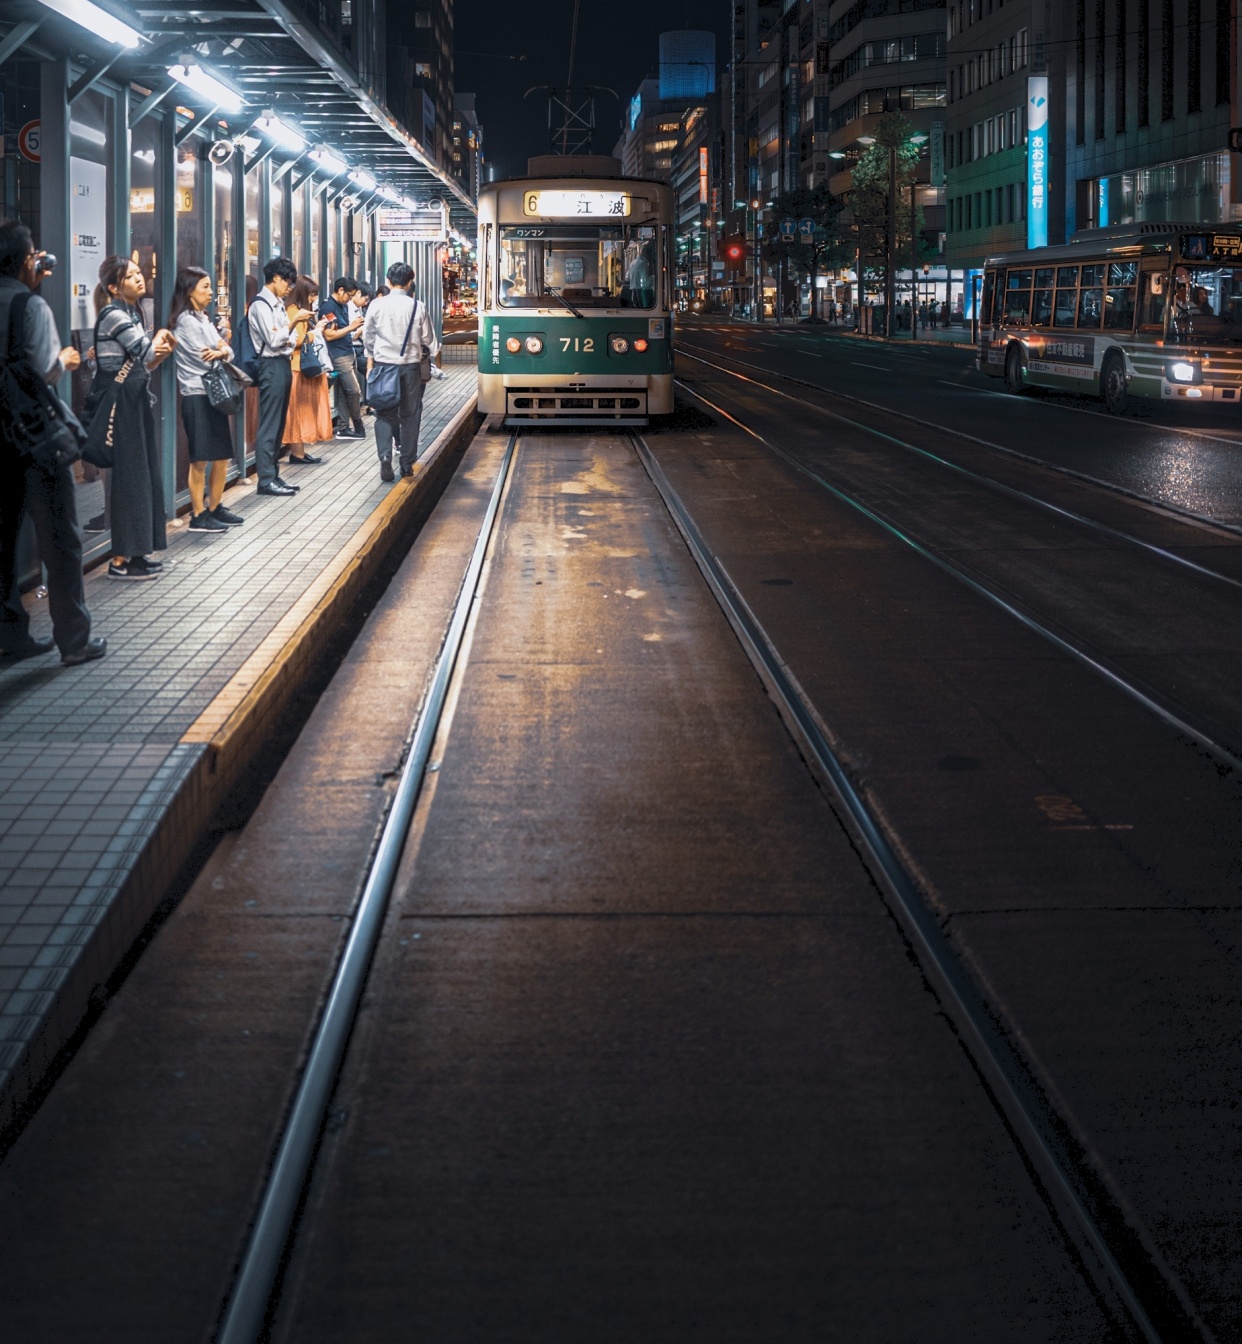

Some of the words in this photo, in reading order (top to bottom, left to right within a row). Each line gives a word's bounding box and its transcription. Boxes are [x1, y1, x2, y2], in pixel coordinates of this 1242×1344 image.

[1032, 136, 1044, 209] あおぞら銀行
[528, 195, 538, 212] 6
[516, 229, 544, 237] ワンマン
[559, 337, 594, 352] 712
